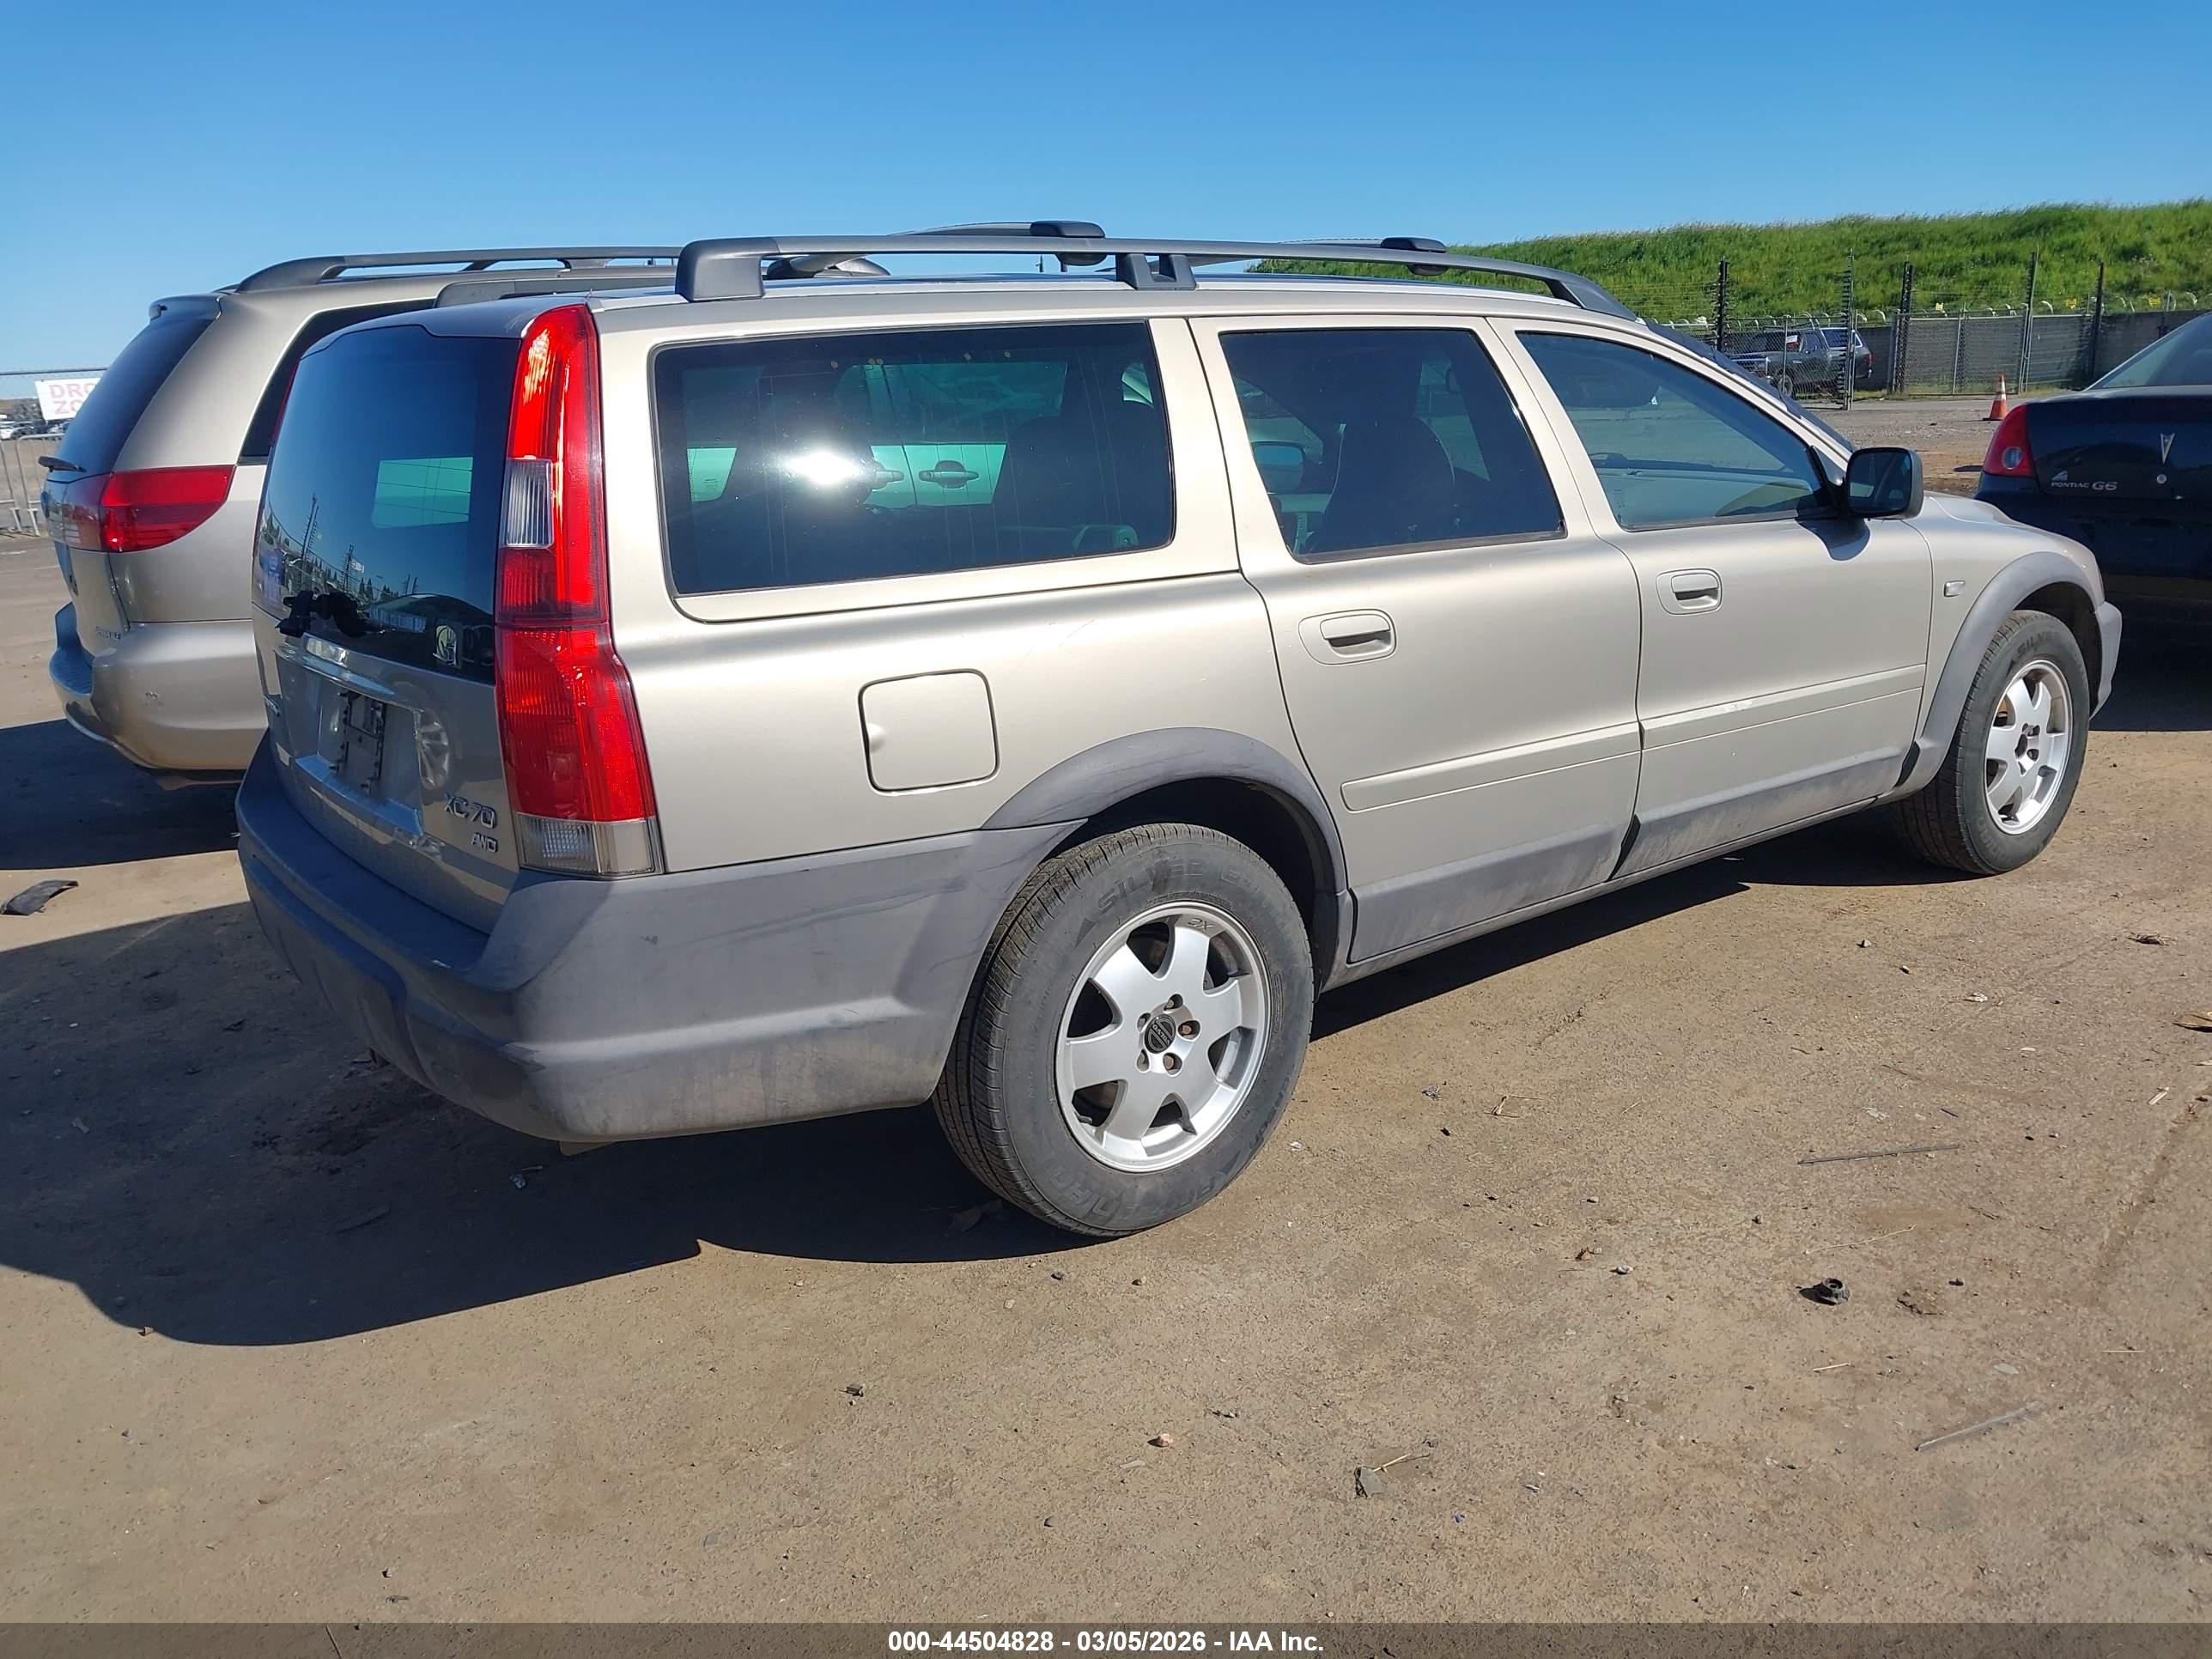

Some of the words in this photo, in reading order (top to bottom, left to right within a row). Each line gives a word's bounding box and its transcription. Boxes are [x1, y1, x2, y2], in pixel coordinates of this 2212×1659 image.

[2092, 480, 2118, 491] G6
[444, 791, 496, 829] XC70
[471, 832, 499, 853] AWD
[1152, 1023, 1172, 1044] VOLVO
